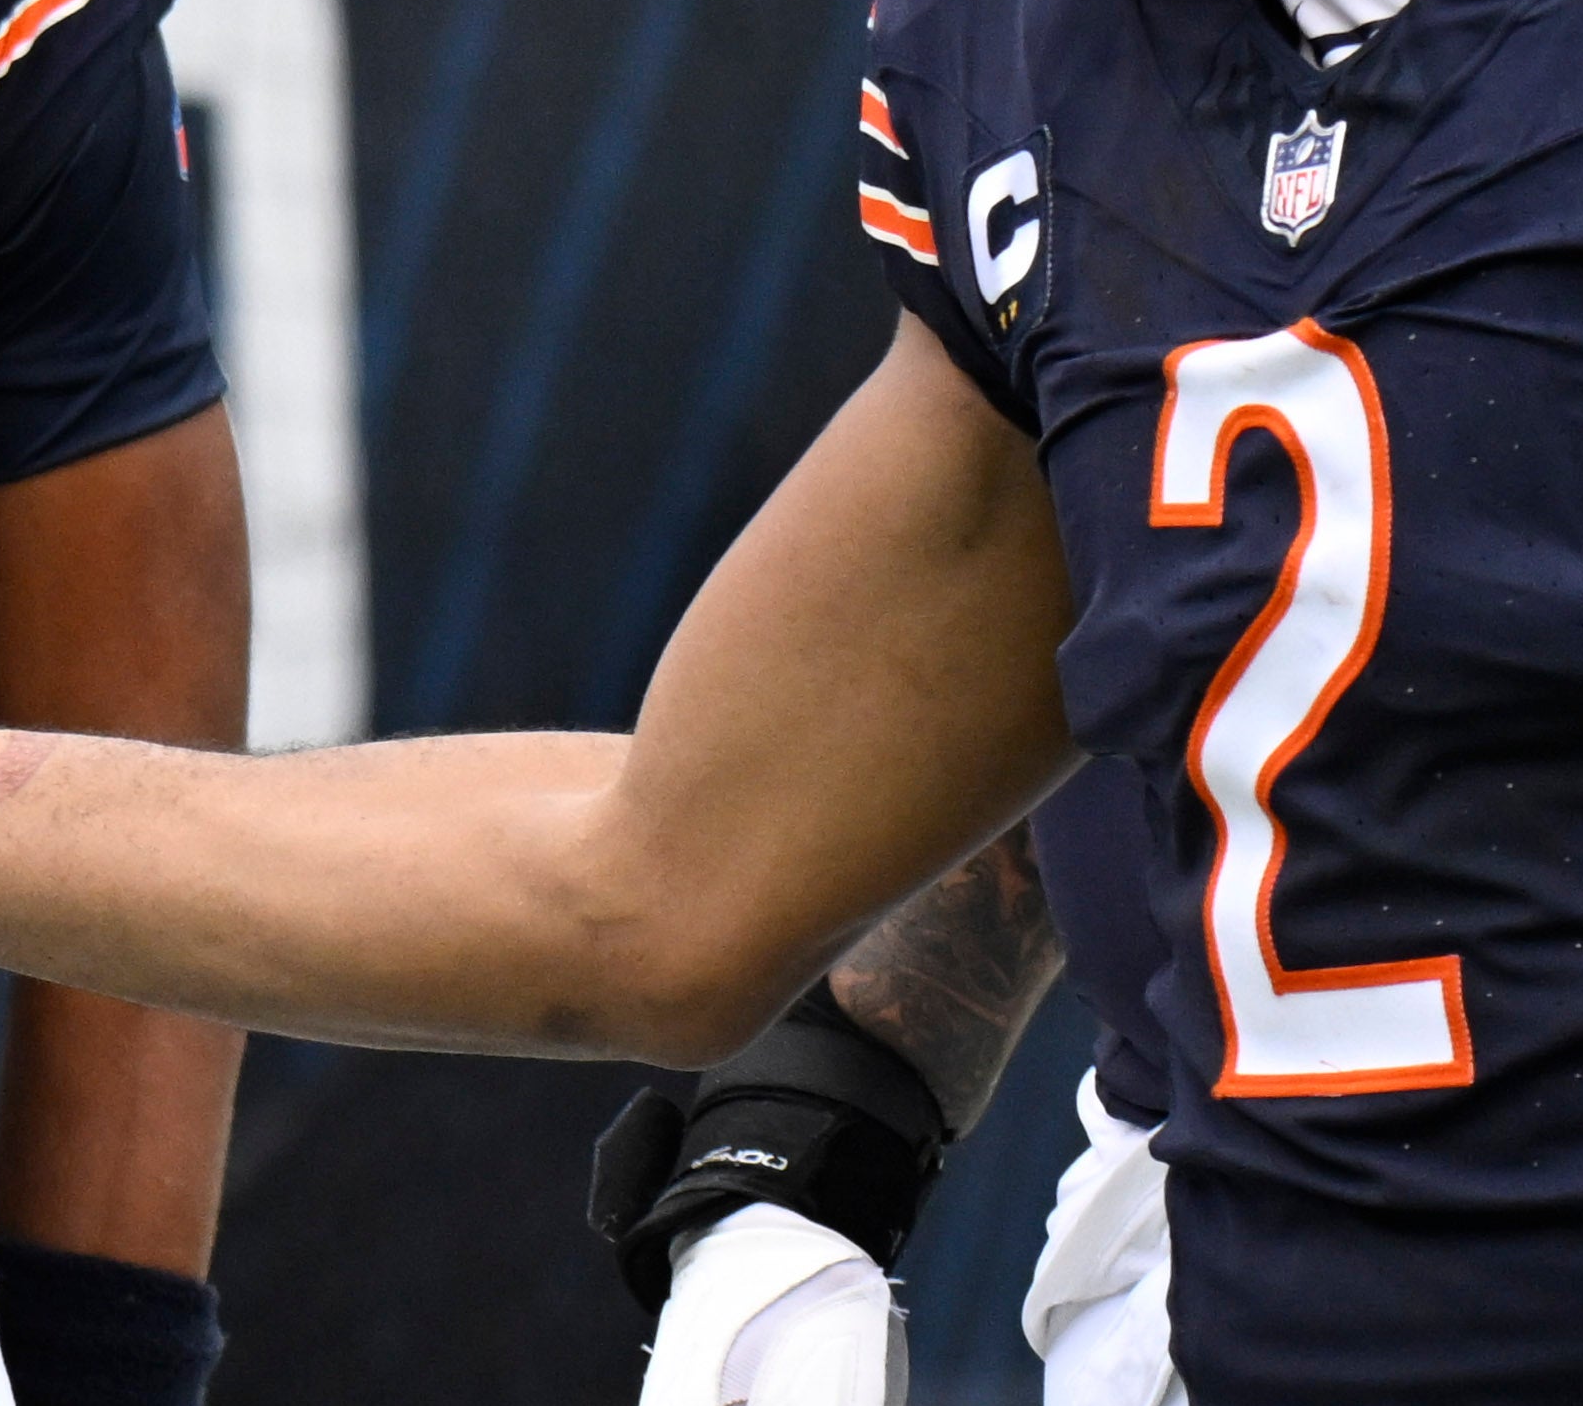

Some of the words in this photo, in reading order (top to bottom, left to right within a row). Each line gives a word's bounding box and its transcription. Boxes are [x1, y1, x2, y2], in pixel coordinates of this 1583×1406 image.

[968, 150, 1040, 305] C
[1275, 170, 1321, 219] NFL
[1149, 317, 1473, 1098] 2
